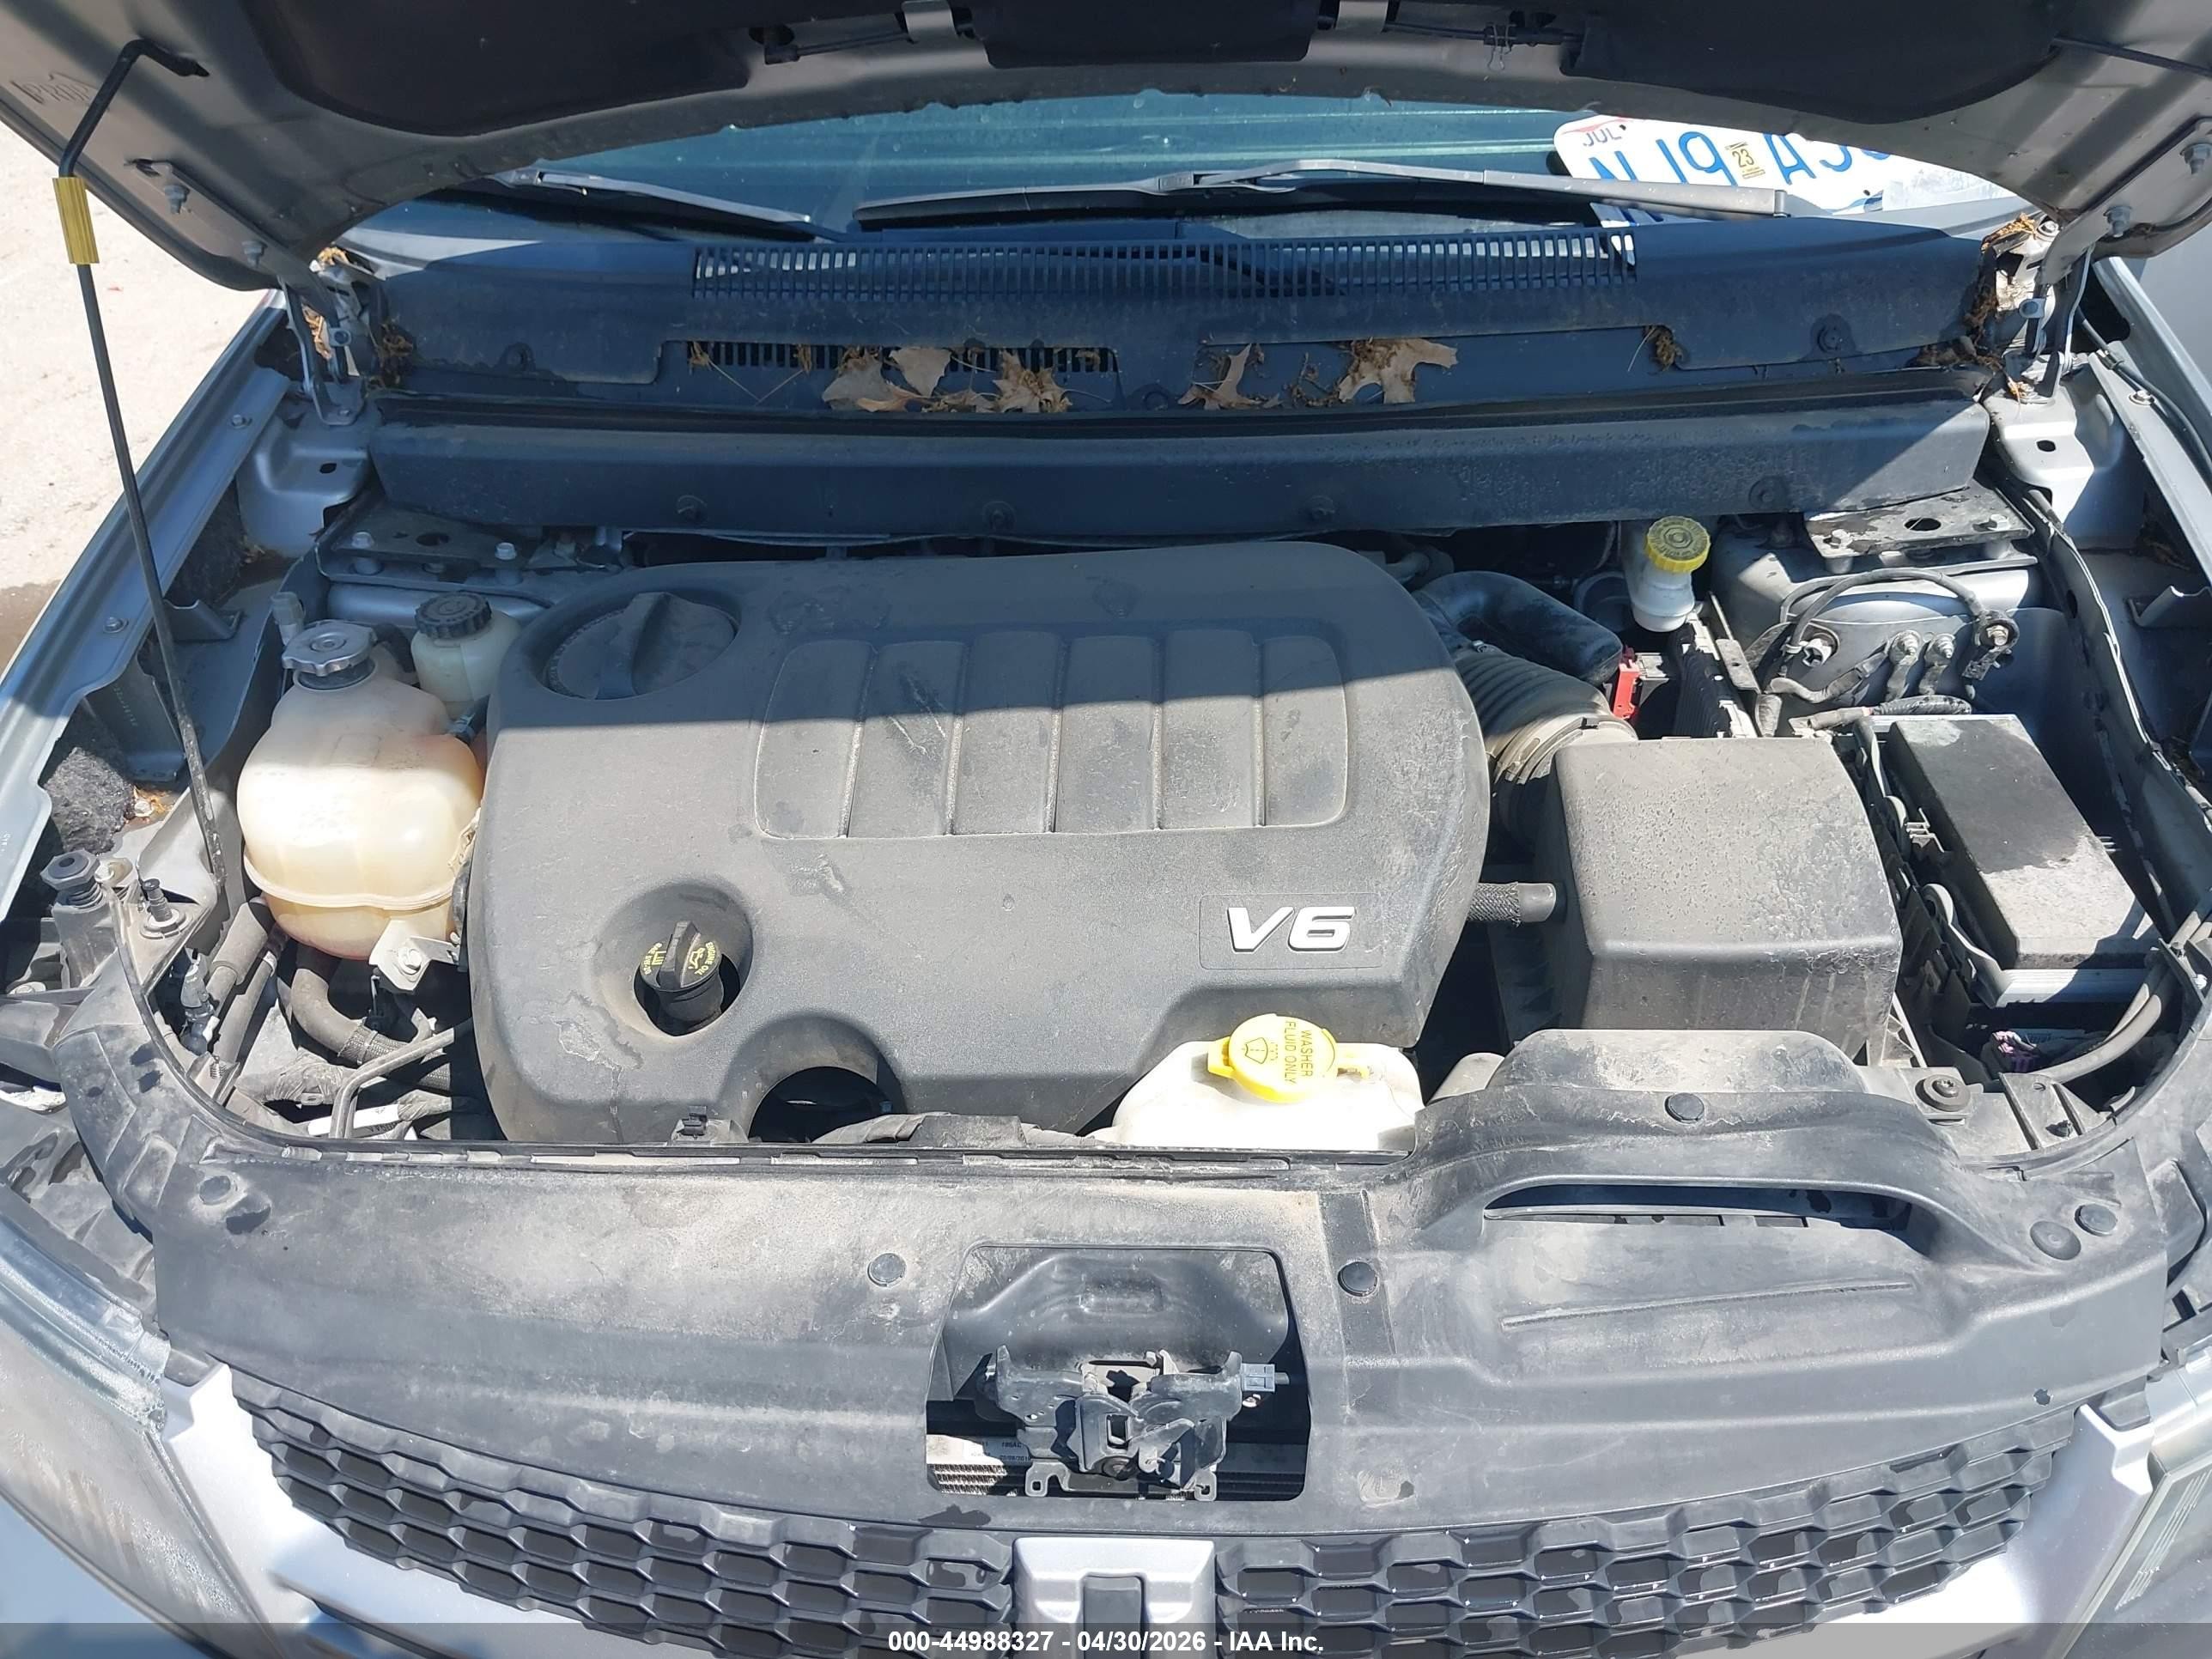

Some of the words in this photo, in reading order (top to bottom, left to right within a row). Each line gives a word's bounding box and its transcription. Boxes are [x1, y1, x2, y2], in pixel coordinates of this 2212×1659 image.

[1583, 128, 1623, 148] JUL
[1731, 149, 1755, 168] 23
[1226, 906, 1358, 953] V6
[705, 941, 716, 965] ENGINE
[694, 964, 709, 975] OIL
[1284, 1020, 1297, 1052] FLUID
[1300, 1030, 1314, 1077] WASHER
[1284, 1055, 1298, 1085] ONLY
